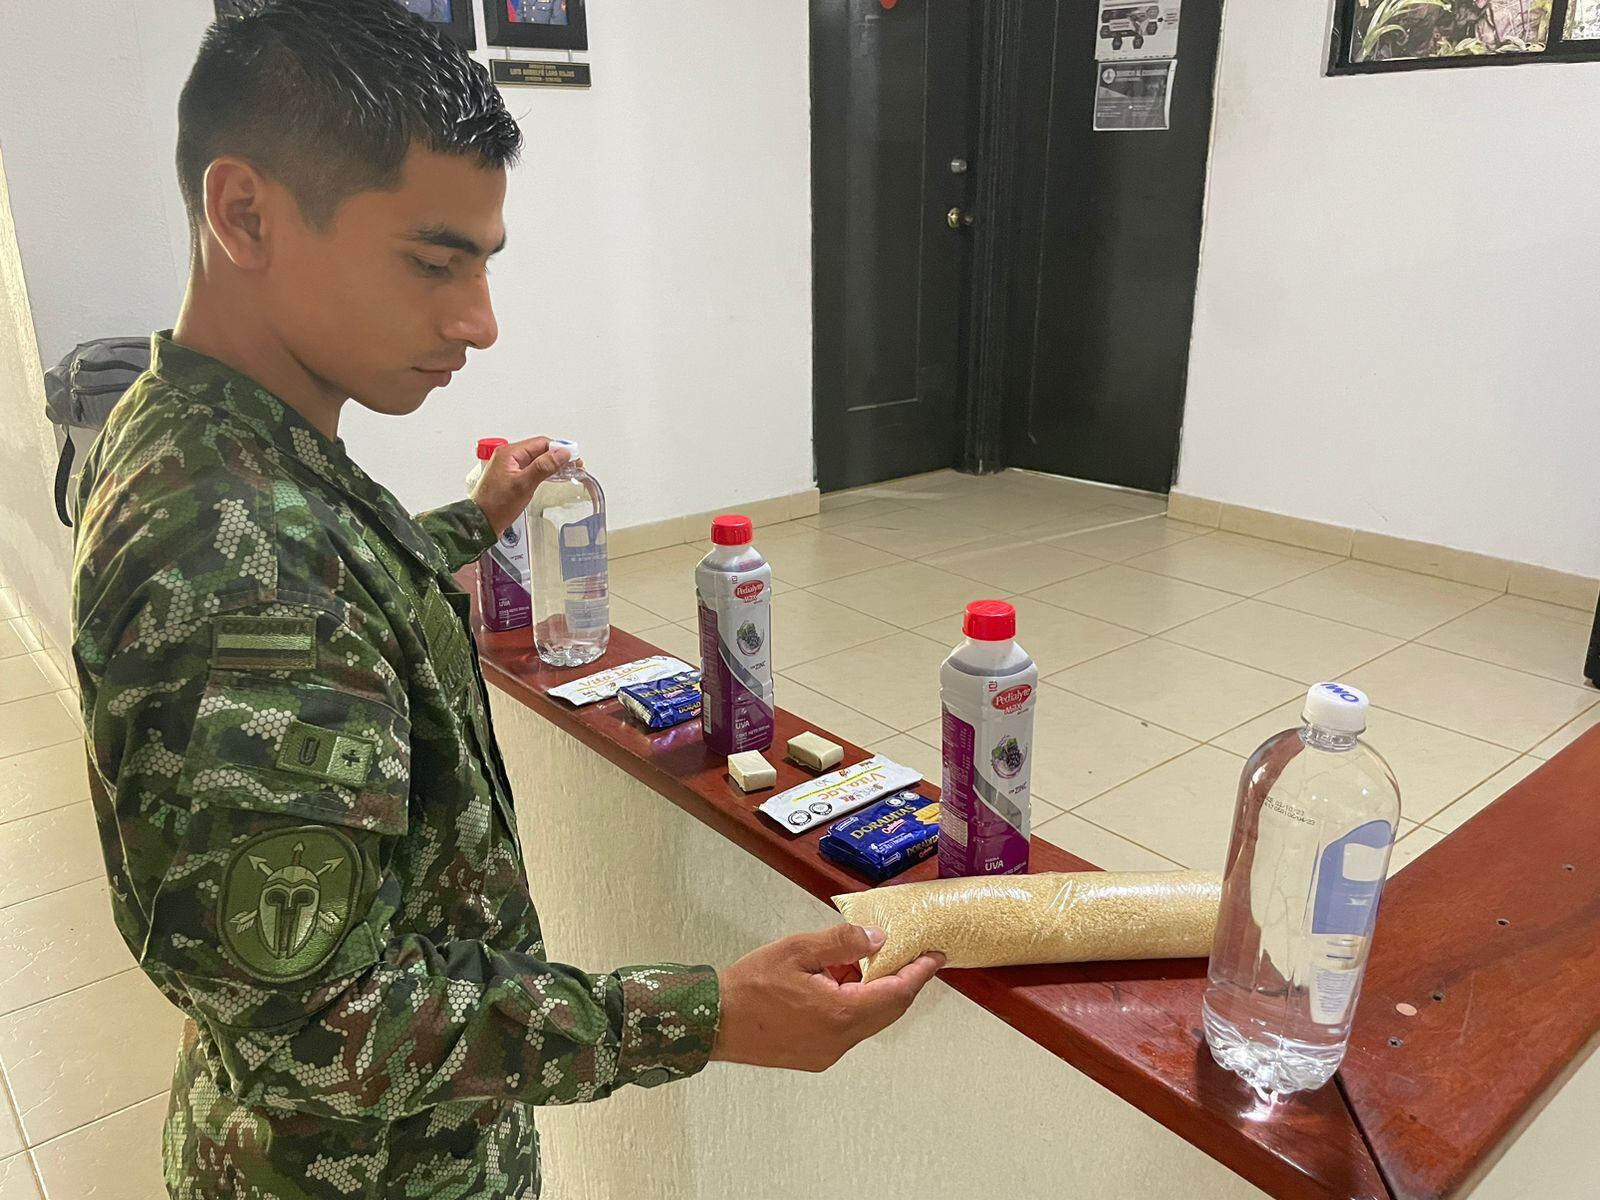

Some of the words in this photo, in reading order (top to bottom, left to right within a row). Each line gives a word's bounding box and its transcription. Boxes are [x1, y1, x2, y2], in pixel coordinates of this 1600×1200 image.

[996, 688, 1031, 706] Pedialyte
[850, 804, 917, 839] DORADITAS
[985, 860, 1004, 871] UVA
